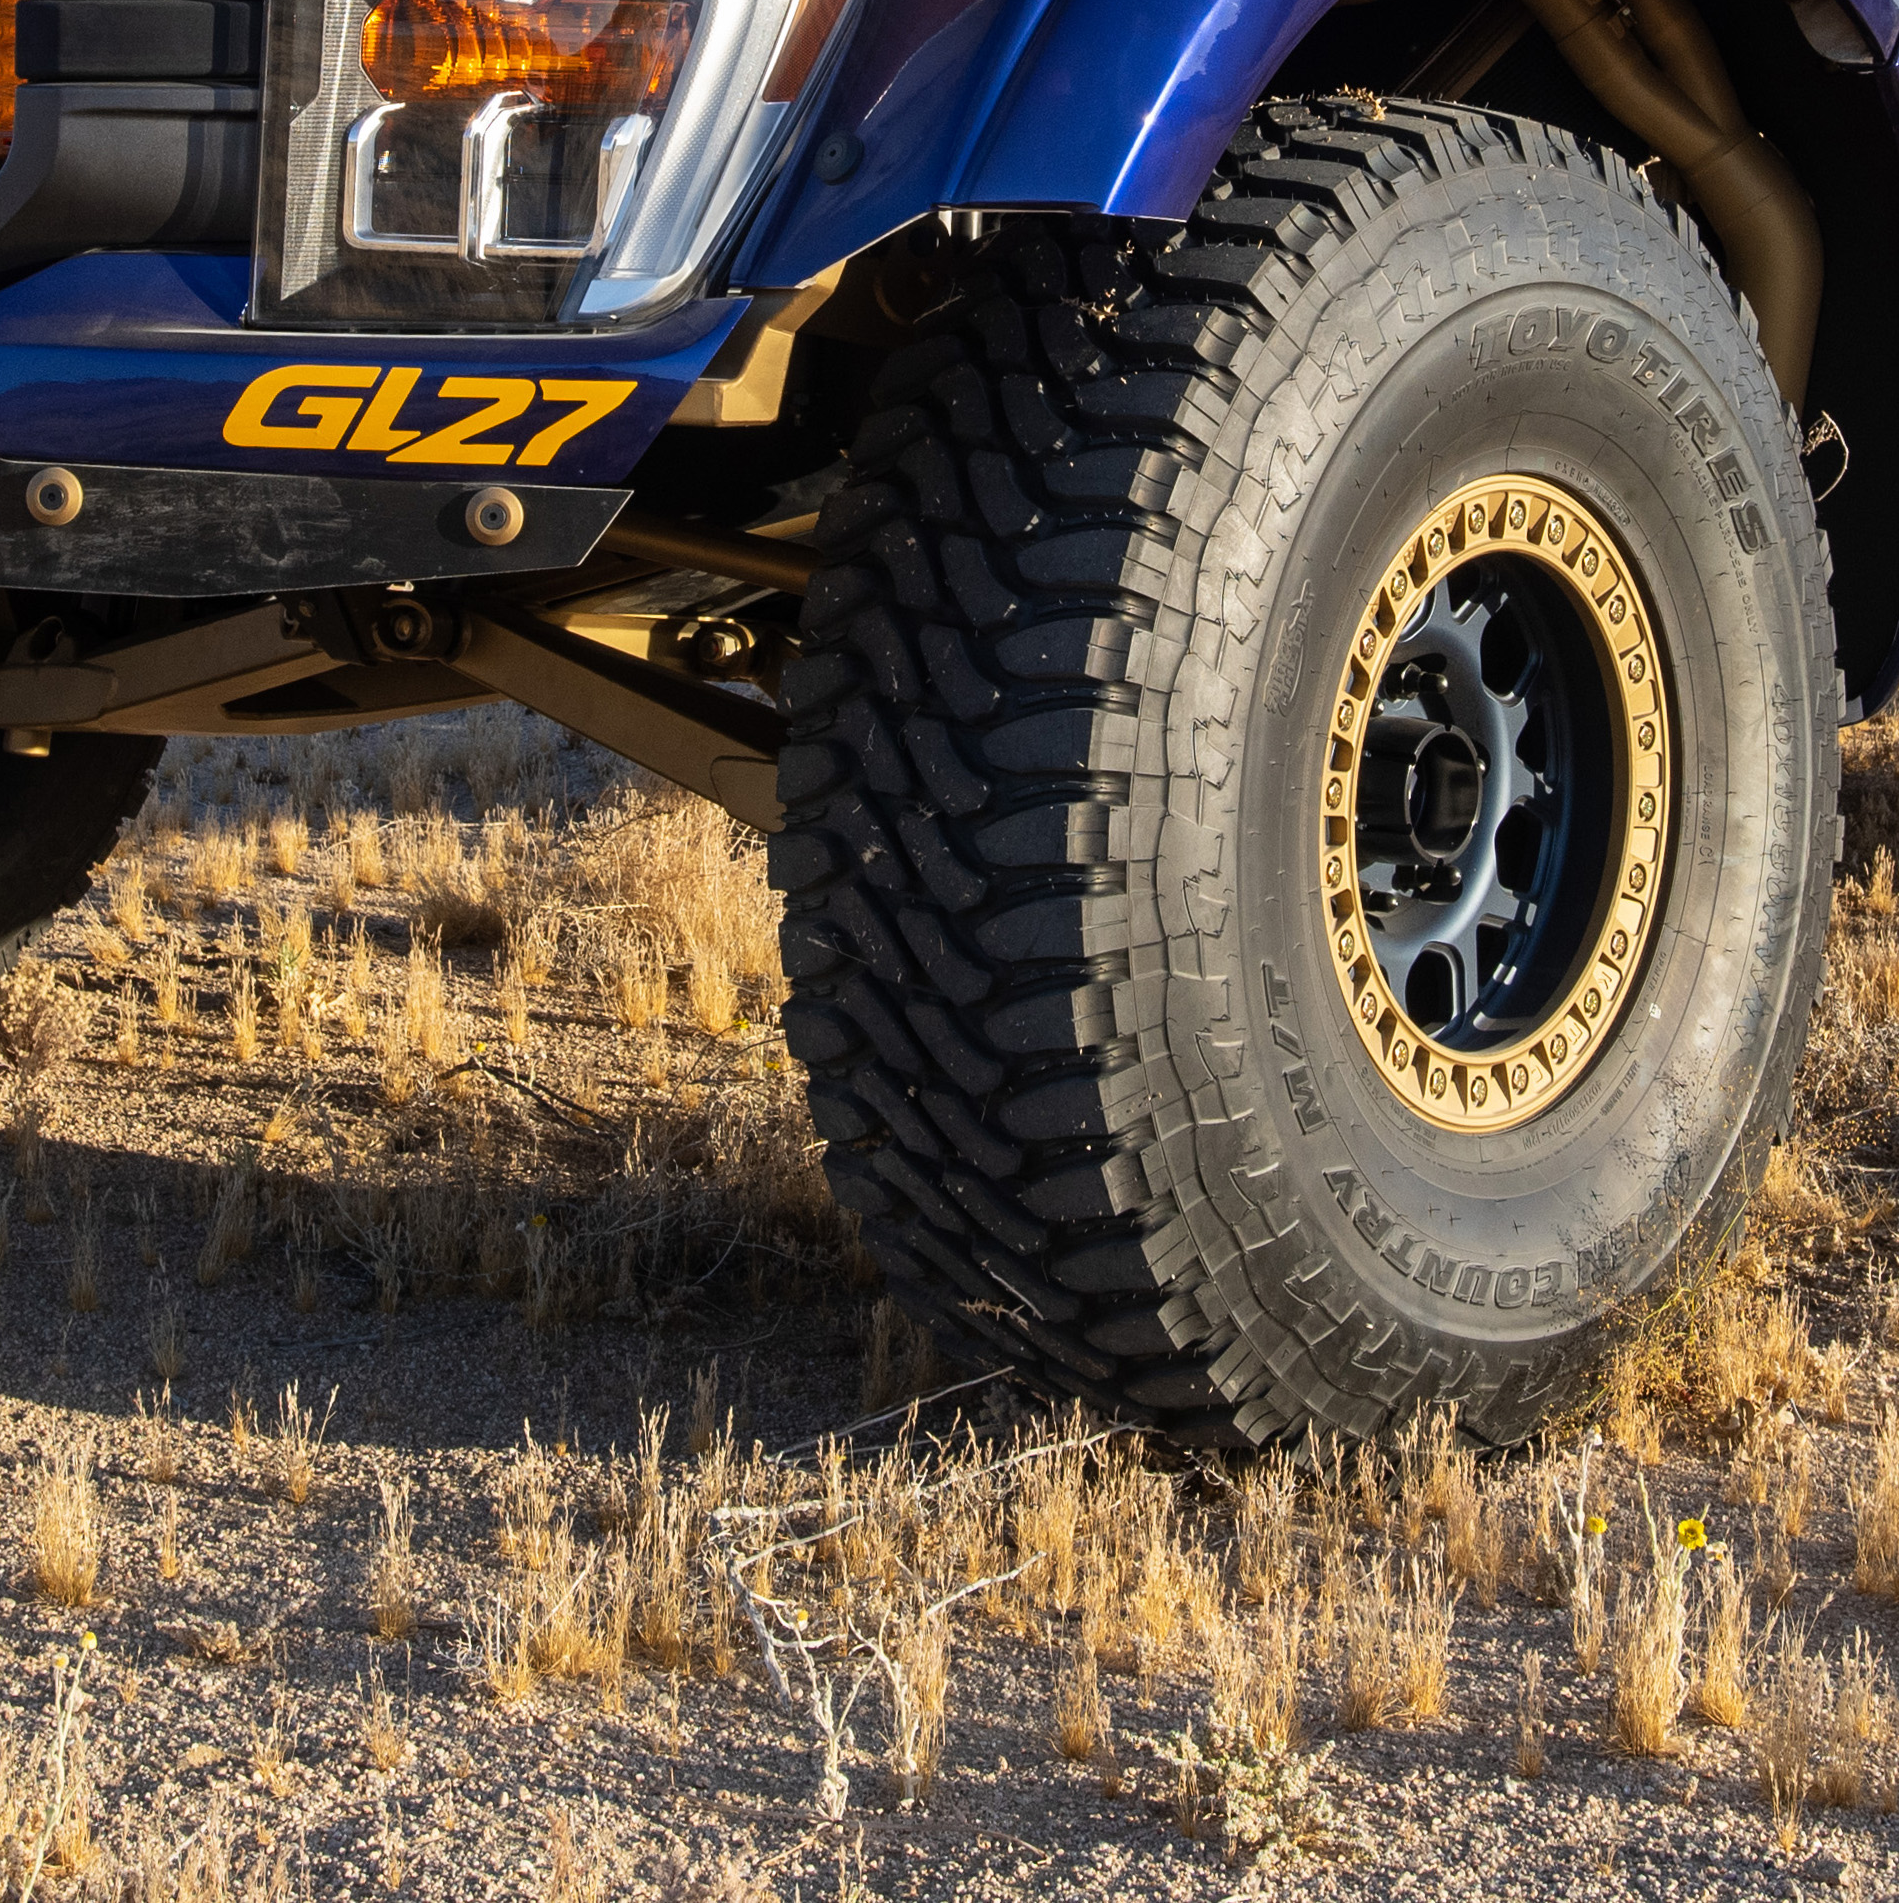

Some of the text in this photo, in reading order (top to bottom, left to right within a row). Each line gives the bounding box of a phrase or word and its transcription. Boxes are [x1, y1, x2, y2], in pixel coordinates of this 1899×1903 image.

[222, 364, 638, 466] GL27
[1471, 303, 1773, 556] TOYO TIRES
[1260, 960, 1325, 1135] M/T
[1322, 1165, 1564, 1308] COUNTRY
